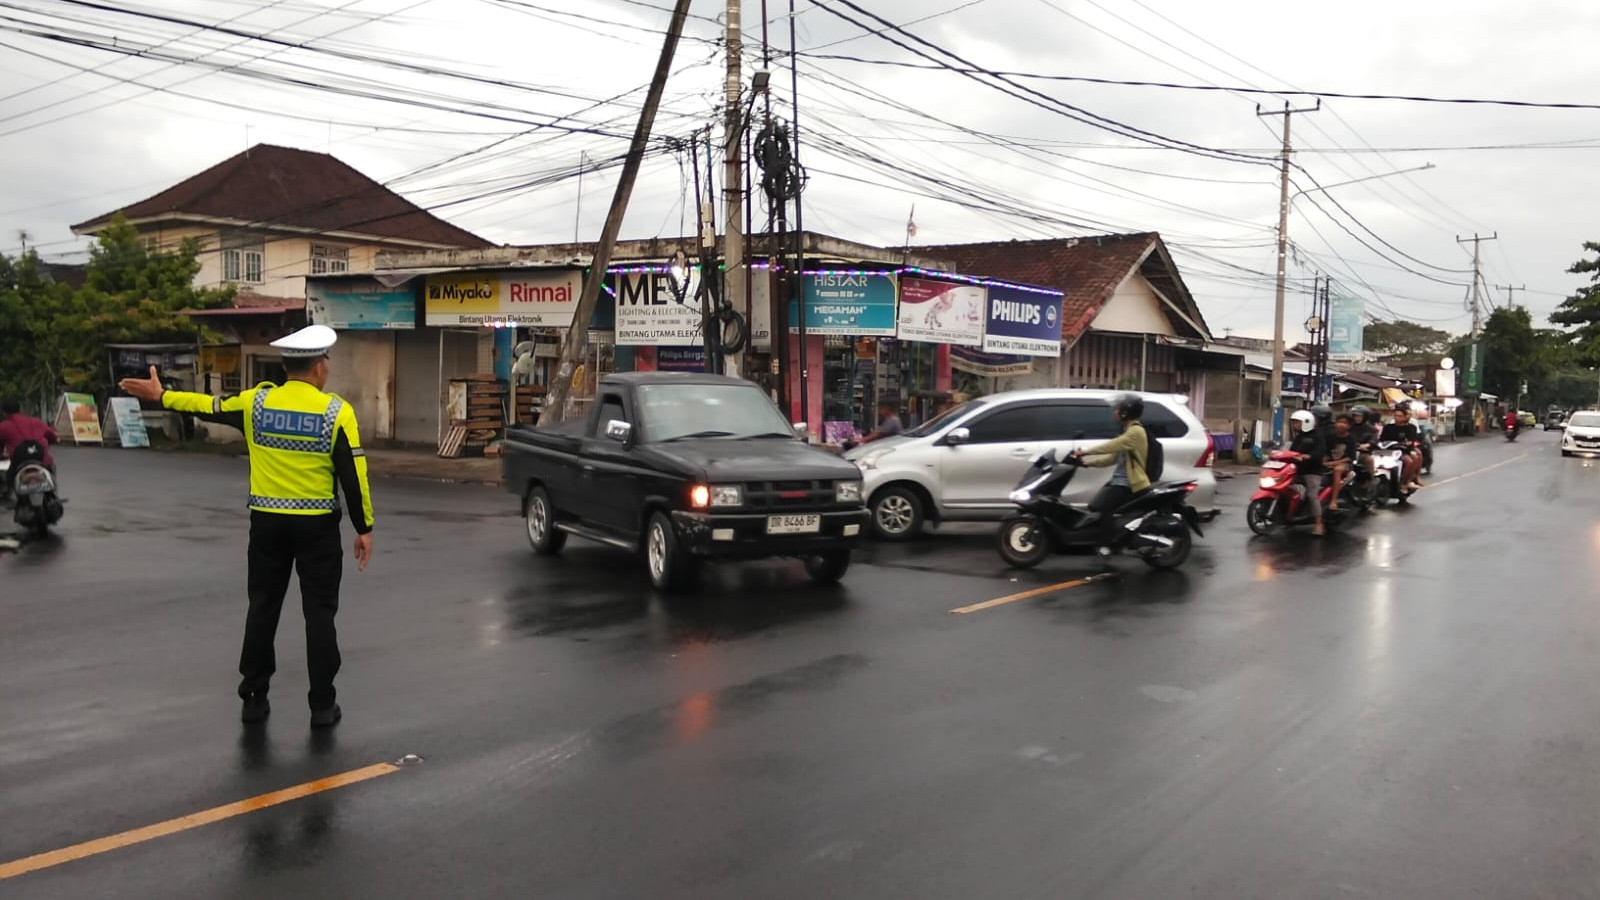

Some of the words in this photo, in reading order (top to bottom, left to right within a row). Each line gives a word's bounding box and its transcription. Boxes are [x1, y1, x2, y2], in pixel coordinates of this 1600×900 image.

[443, 283, 492, 303] Miyako
[510, 282, 572, 303] Rinnai
[459, 315, 484, 324] Bintang
[484, 315, 507, 323] Utama
[507, 314, 543, 323] Elektronik
[618, 308, 651, 316] LIGHTING
[992, 299, 1041, 325] PHILIPS
[618, 330, 650, 338] BINTANG
[650, 330, 676, 338] UTAMA
[262, 411, 320, 433] POLISI
